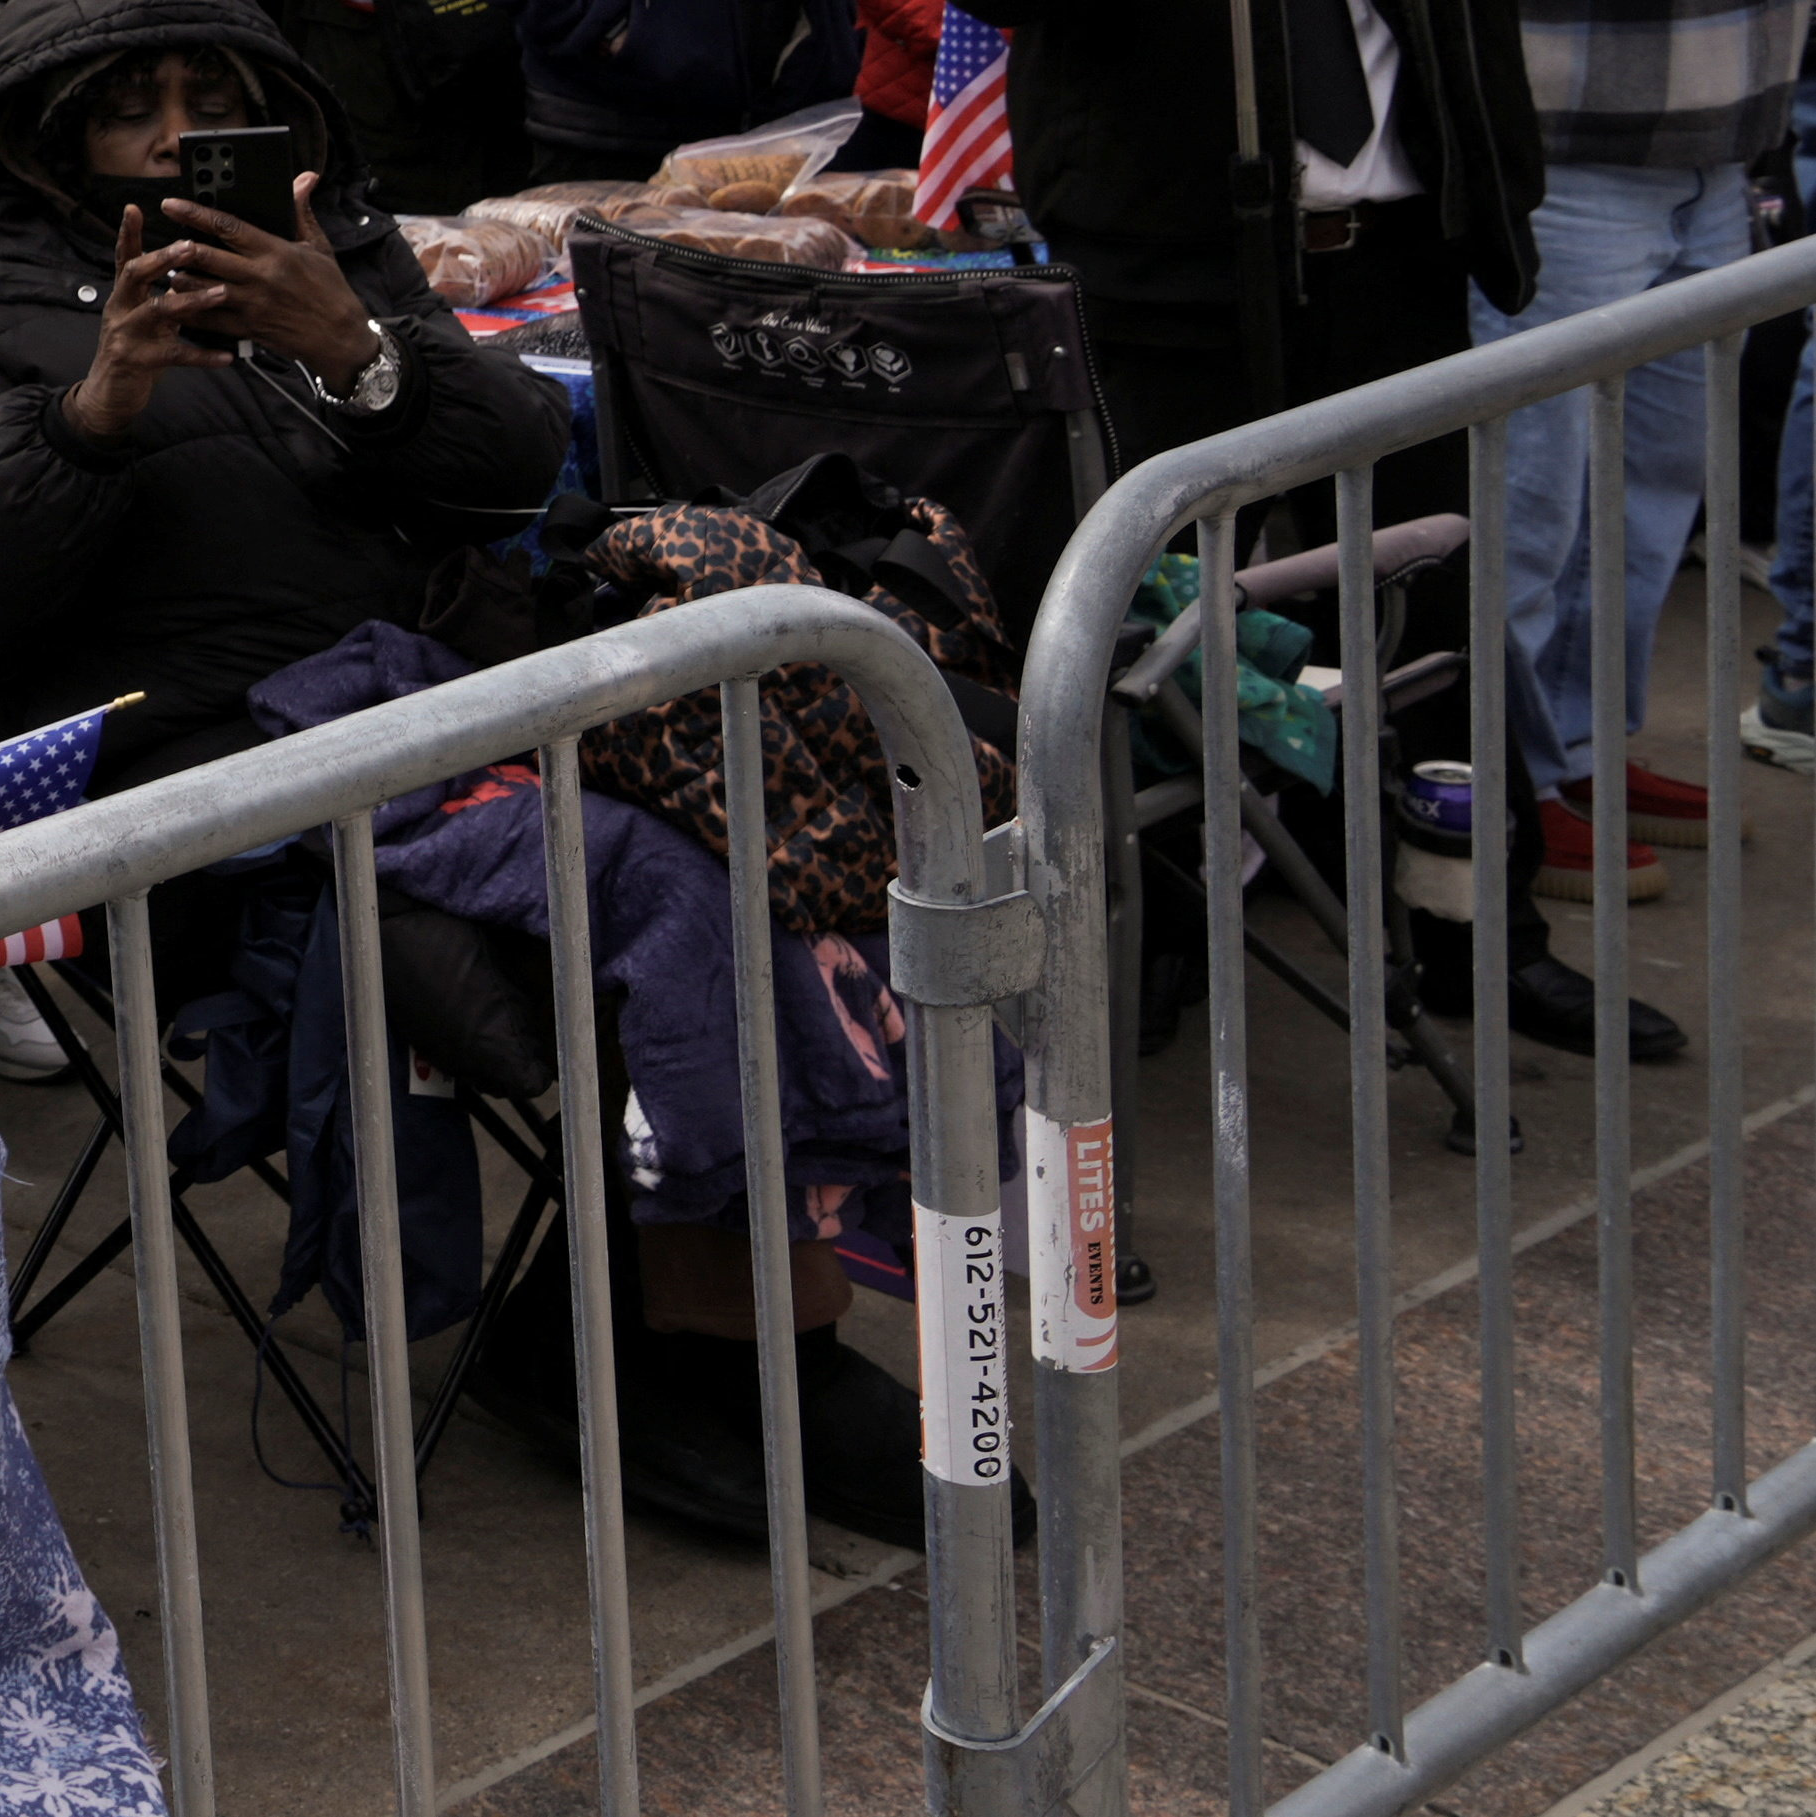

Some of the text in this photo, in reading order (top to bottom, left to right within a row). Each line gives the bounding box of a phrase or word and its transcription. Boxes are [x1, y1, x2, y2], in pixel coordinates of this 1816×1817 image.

[1077, 1141, 1105, 1232] LITES
[1087, 1241, 1104, 1305] EVENTS
[964, 1226, 1002, 1479] 612-521-4200
